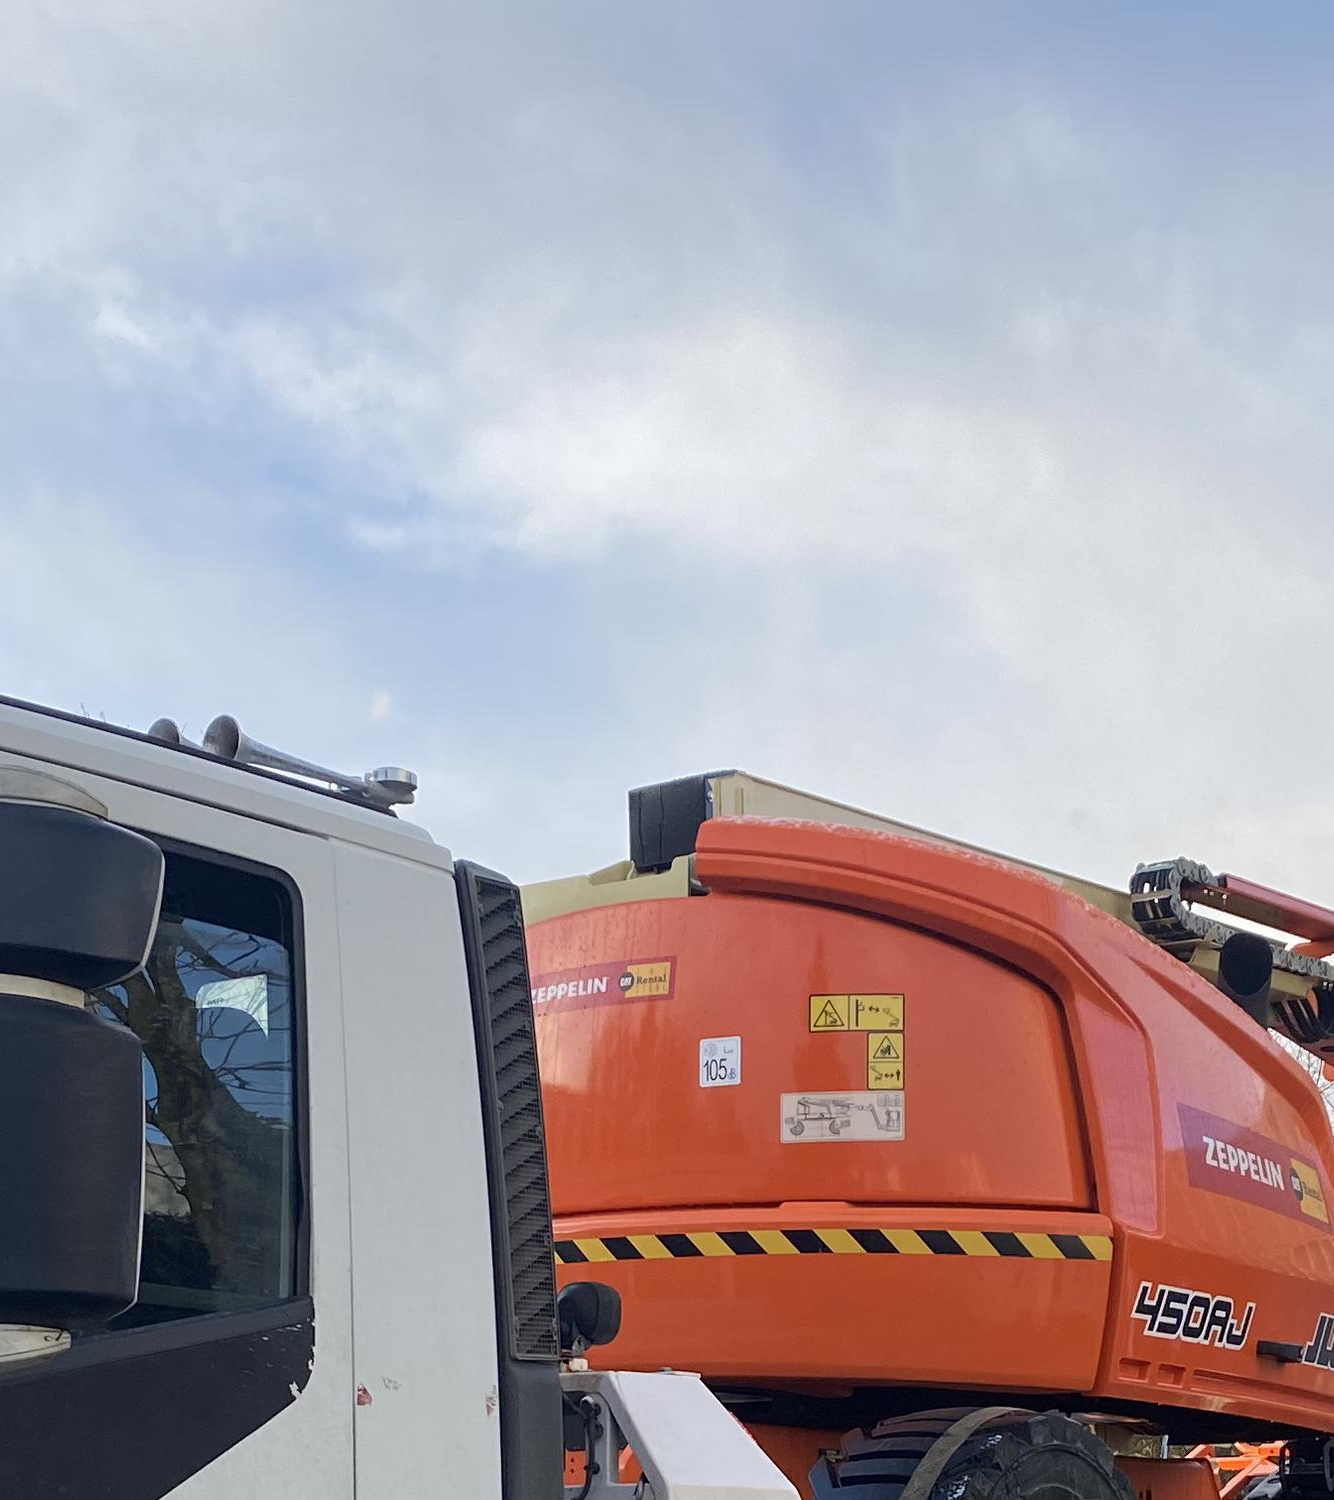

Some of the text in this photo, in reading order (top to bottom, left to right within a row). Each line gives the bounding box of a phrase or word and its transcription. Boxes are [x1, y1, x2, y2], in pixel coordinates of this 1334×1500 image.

[703, 1058, 727, 1082] 105
[1202, 1135, 1285, 1191] ZEPPELIN
[1130, 1281, 1256, 1350] 450AJ
